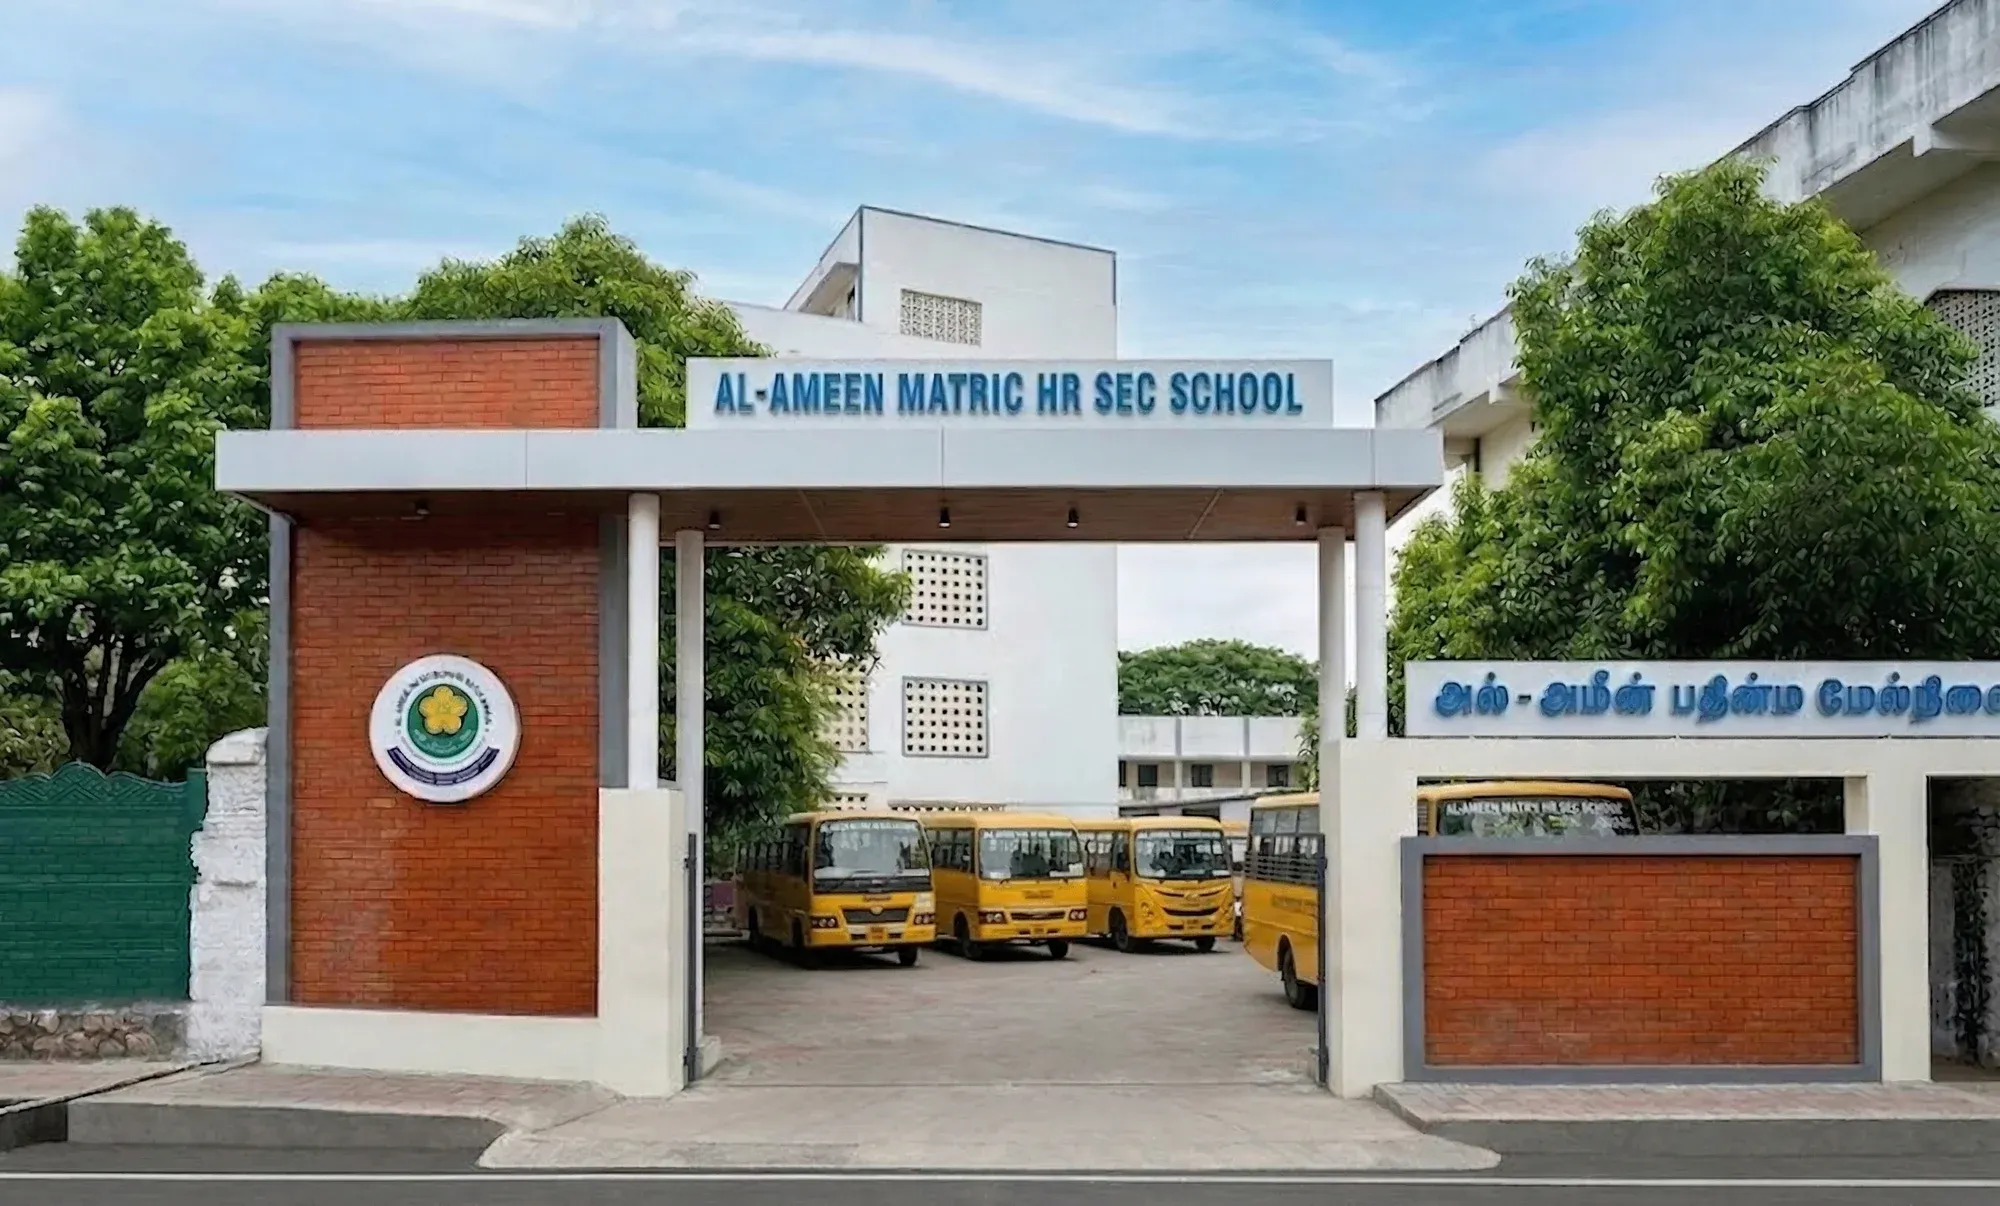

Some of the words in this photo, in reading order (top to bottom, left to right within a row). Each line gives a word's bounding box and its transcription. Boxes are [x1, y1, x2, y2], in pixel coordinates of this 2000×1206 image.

[715, 372, 885, 415] AL-AMEEN
[897, 372, 1024, 415] MATRIC
[1037, 372, 1081, 414] HR
[1094, 372, 1156, 415] SEC
[1170, 372, 1303, 415] SCHOOL
[1670, 671, 1805, 724] பதின்ம
